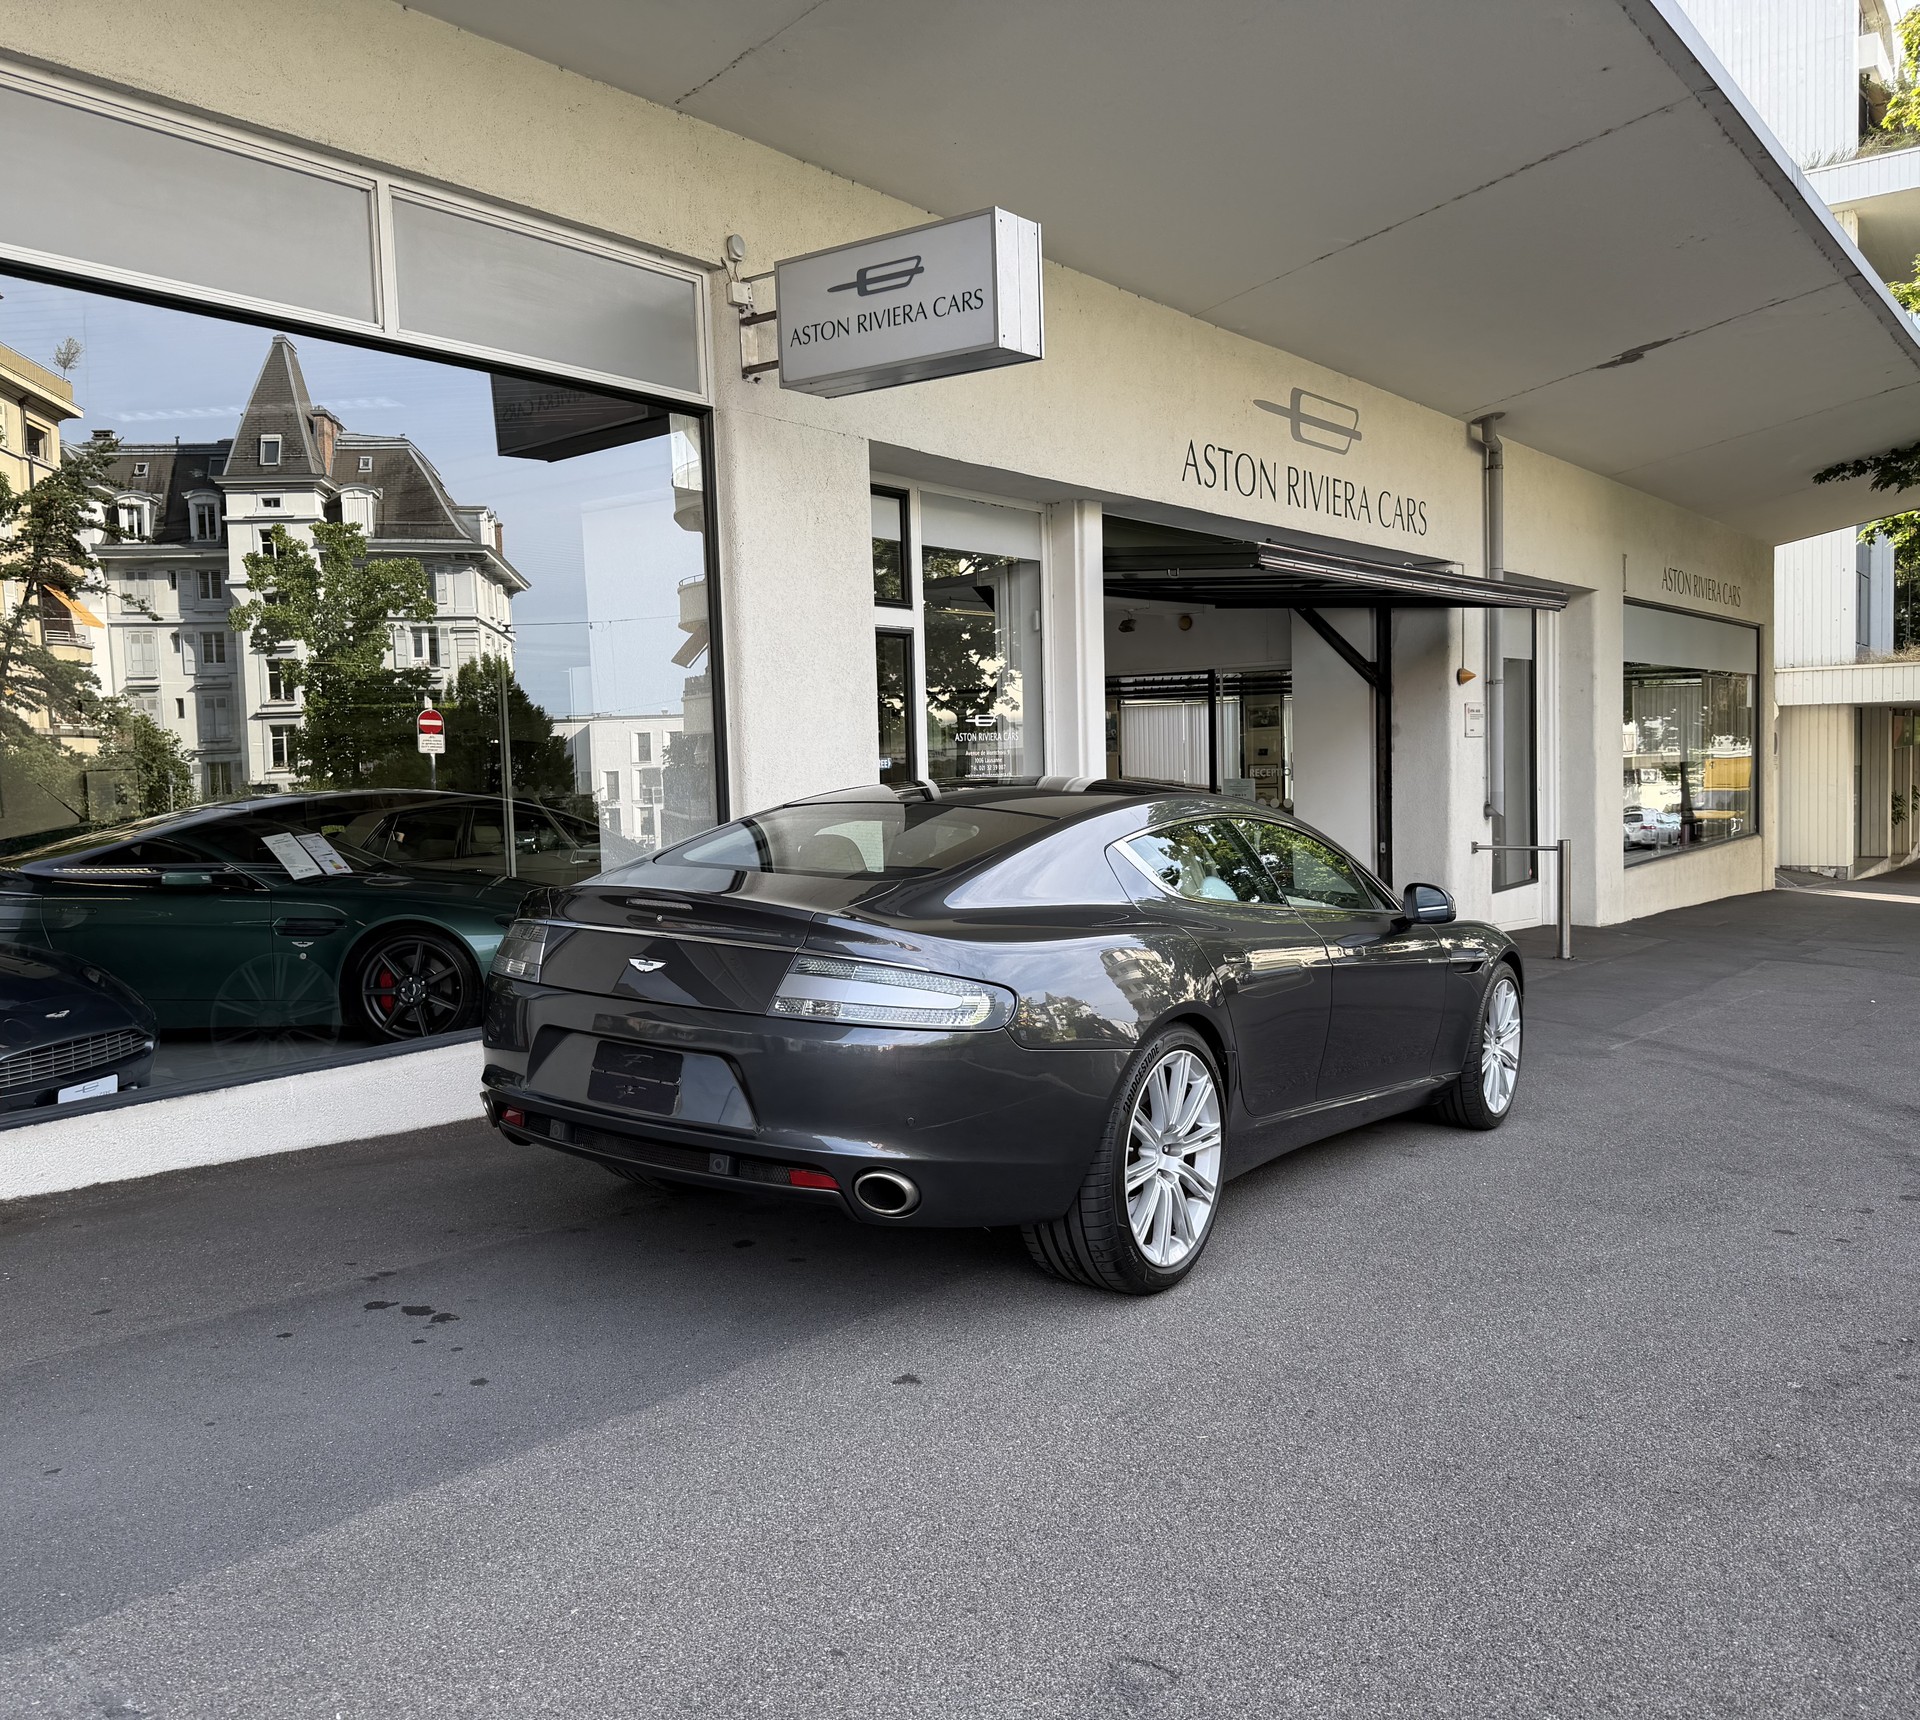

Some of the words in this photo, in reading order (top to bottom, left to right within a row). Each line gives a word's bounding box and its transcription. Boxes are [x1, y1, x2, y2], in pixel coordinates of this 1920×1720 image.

[790, 317, 850, 348] ASTON
[857, 301, 928, 334] RIVIERA
[933, 288, 984, 318] CARS
[1181, 439, 1277, 503] ASTON
[1287, 465, 1372, 524] RIVIERA
[1378, 490, 1428, 536] CARS
[1661, 566, 1692, 596] ASTON
[1693, 574, 1722, 603] RIVIERA
[1722, 582, 1742, 608] CARS
[954, 732, 977, 742] ASTON
[978, 732, 1002, 741] RIVIERA
[1003, 732, 1019, 741] CARS
[1249, 768, 1292, 777] RECEPTIO
[1122, 1043, 1161, 1115] BRIDGESTONE
